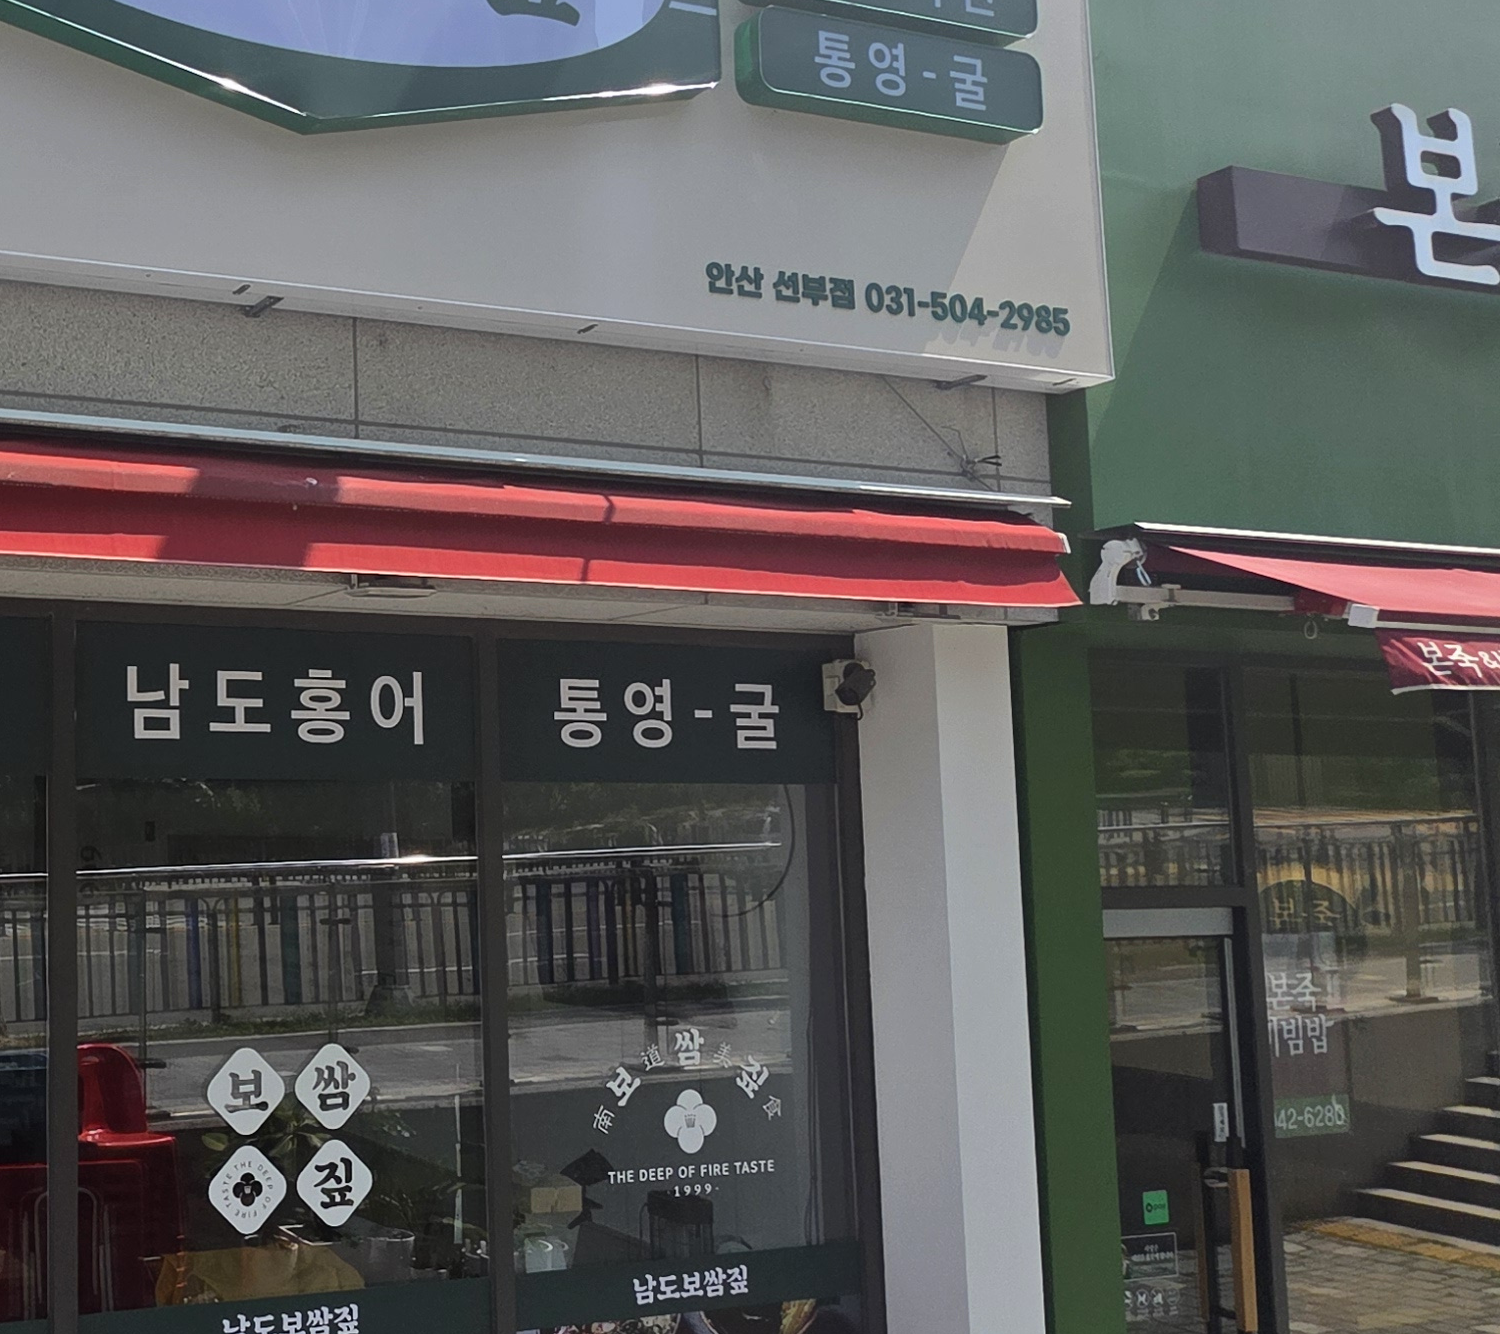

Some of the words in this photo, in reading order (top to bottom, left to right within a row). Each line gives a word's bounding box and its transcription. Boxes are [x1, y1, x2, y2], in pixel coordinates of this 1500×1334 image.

[705, 261, 764, 299] 안산
[773, 270, 856, 310] 선부점
[865, 282, 1071, 336] 031-504-2985
[126, 663, 425, 745] 남도홍어
[608, 1170, 635, 1185] THE
[639, 1167, 674, 1182] DEEP
[678, 1164, 697, 1179] OF
[700, 1162, 730, 1178] FIRE
[734, 1159, 775, 1175] TASTE
[674, 1183, 714, 1197] 1999
[632, 1265, 749, 1305] 남도보쌈짚
